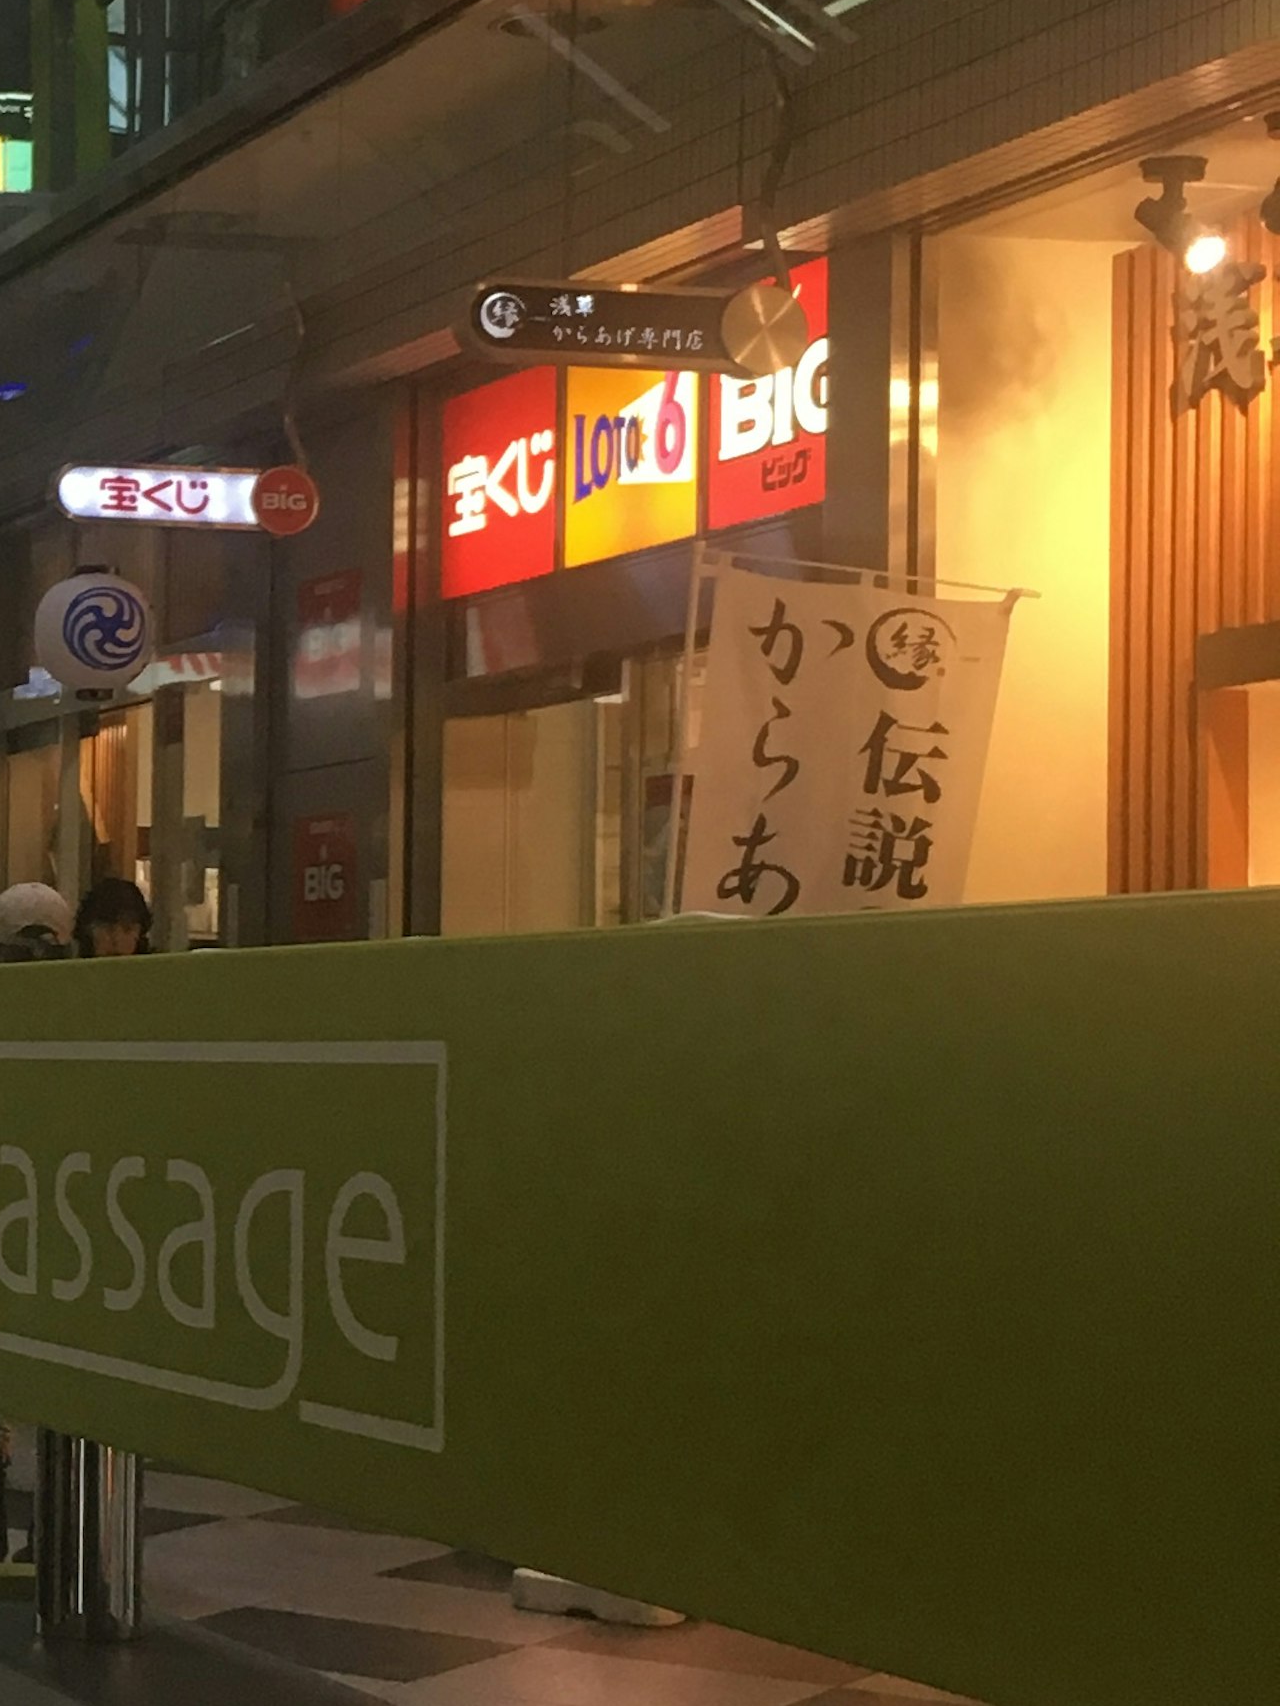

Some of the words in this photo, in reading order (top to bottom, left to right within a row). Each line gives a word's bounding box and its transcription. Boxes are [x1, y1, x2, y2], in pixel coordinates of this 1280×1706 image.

[549, 294, 596, 317] 浅草
[552, 325, 704, 351] からあげ専門店
[448, 426, 553, 537] 宝くじ
[761, 447, 811, 492] ビッグ
[100, 476, 209, 514] 宝くじ
[261, 485, 307, 510] BIG
[842, 710, 949, 899] 伝説
[304, 863, 344, 901] BIG
